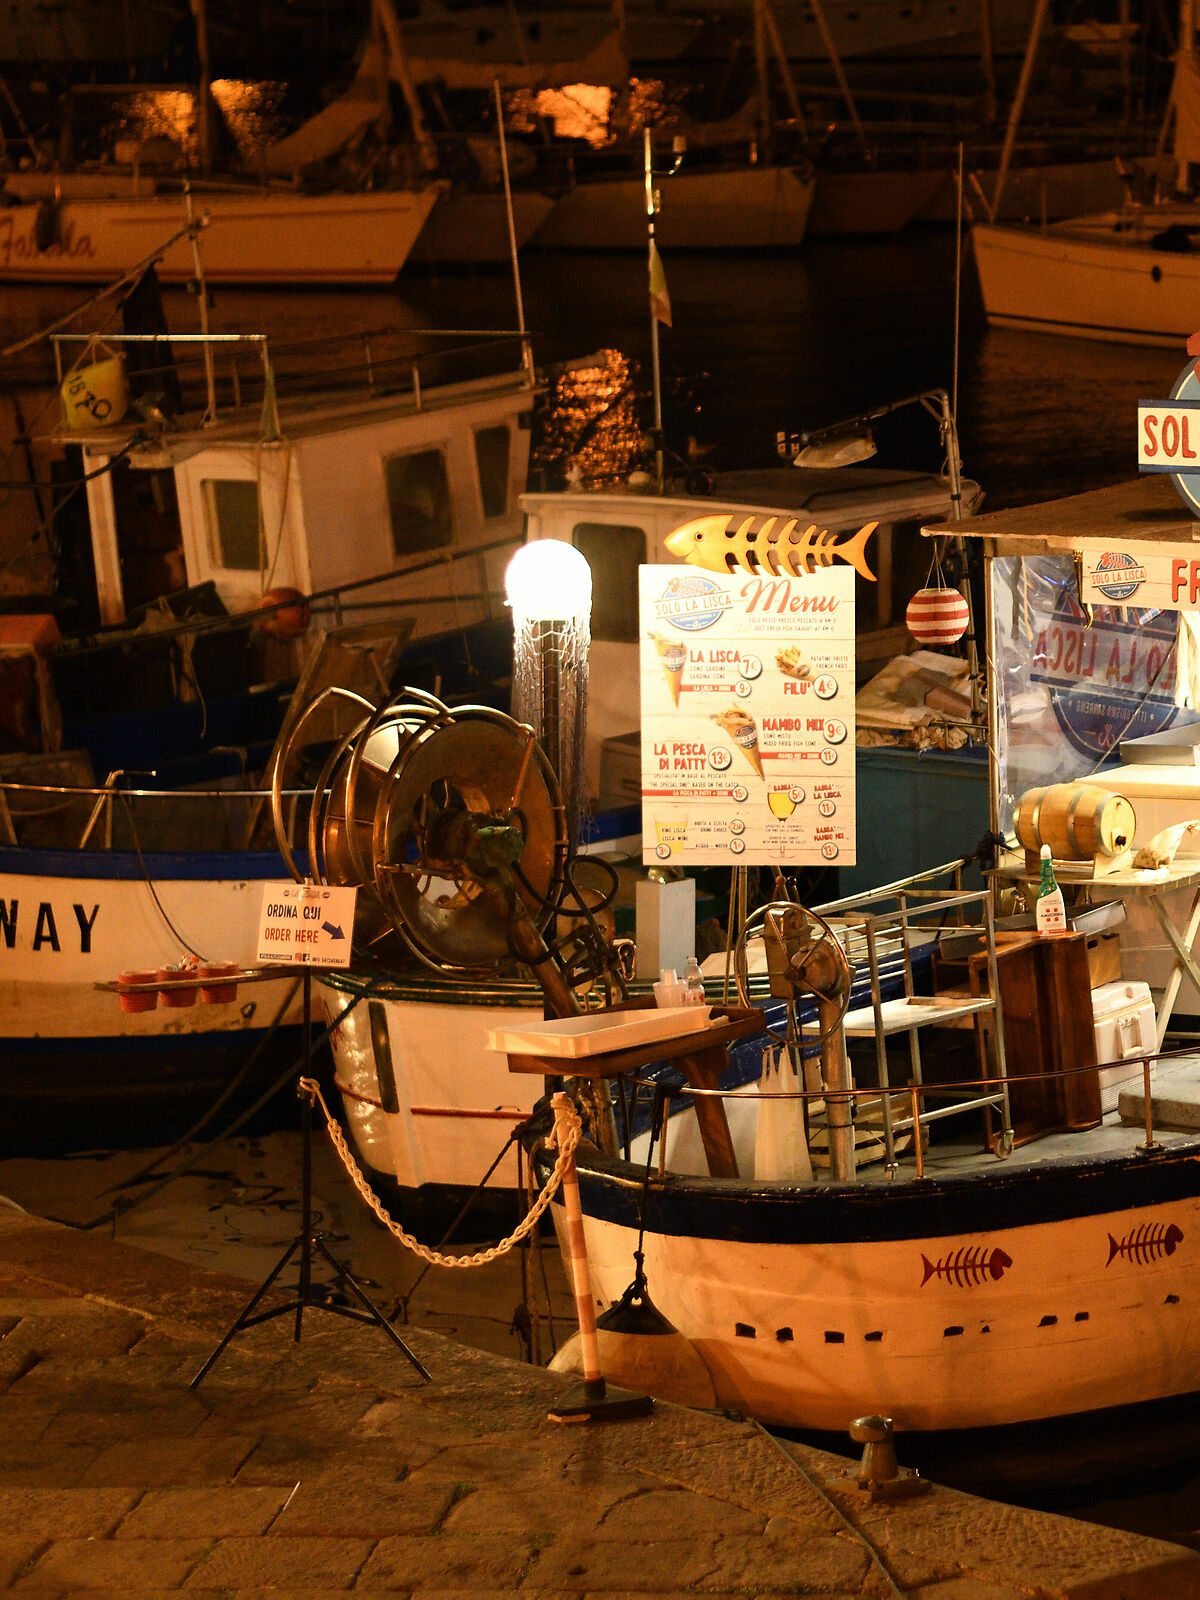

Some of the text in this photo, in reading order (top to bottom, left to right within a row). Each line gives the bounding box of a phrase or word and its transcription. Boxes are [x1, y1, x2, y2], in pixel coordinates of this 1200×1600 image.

[1091, 569, 1145, 585] SOLO LA LISCA
[740, 578, 840, 613] Menu
[655, 594, 732, 616] SOLO LA LISCA
[690, 650, 704, 663] LA
[709, 650, 741, 663] LISCA
[762, 718, 825, 731] MAMBO MIX
[654, 743, 706, 755] LA PESCA
[659, 757, 706, 770] DI PATTY
[267, 904, 321, 920] ORDINA QUI
[264, 927, 319, 944] ORDER HERE
